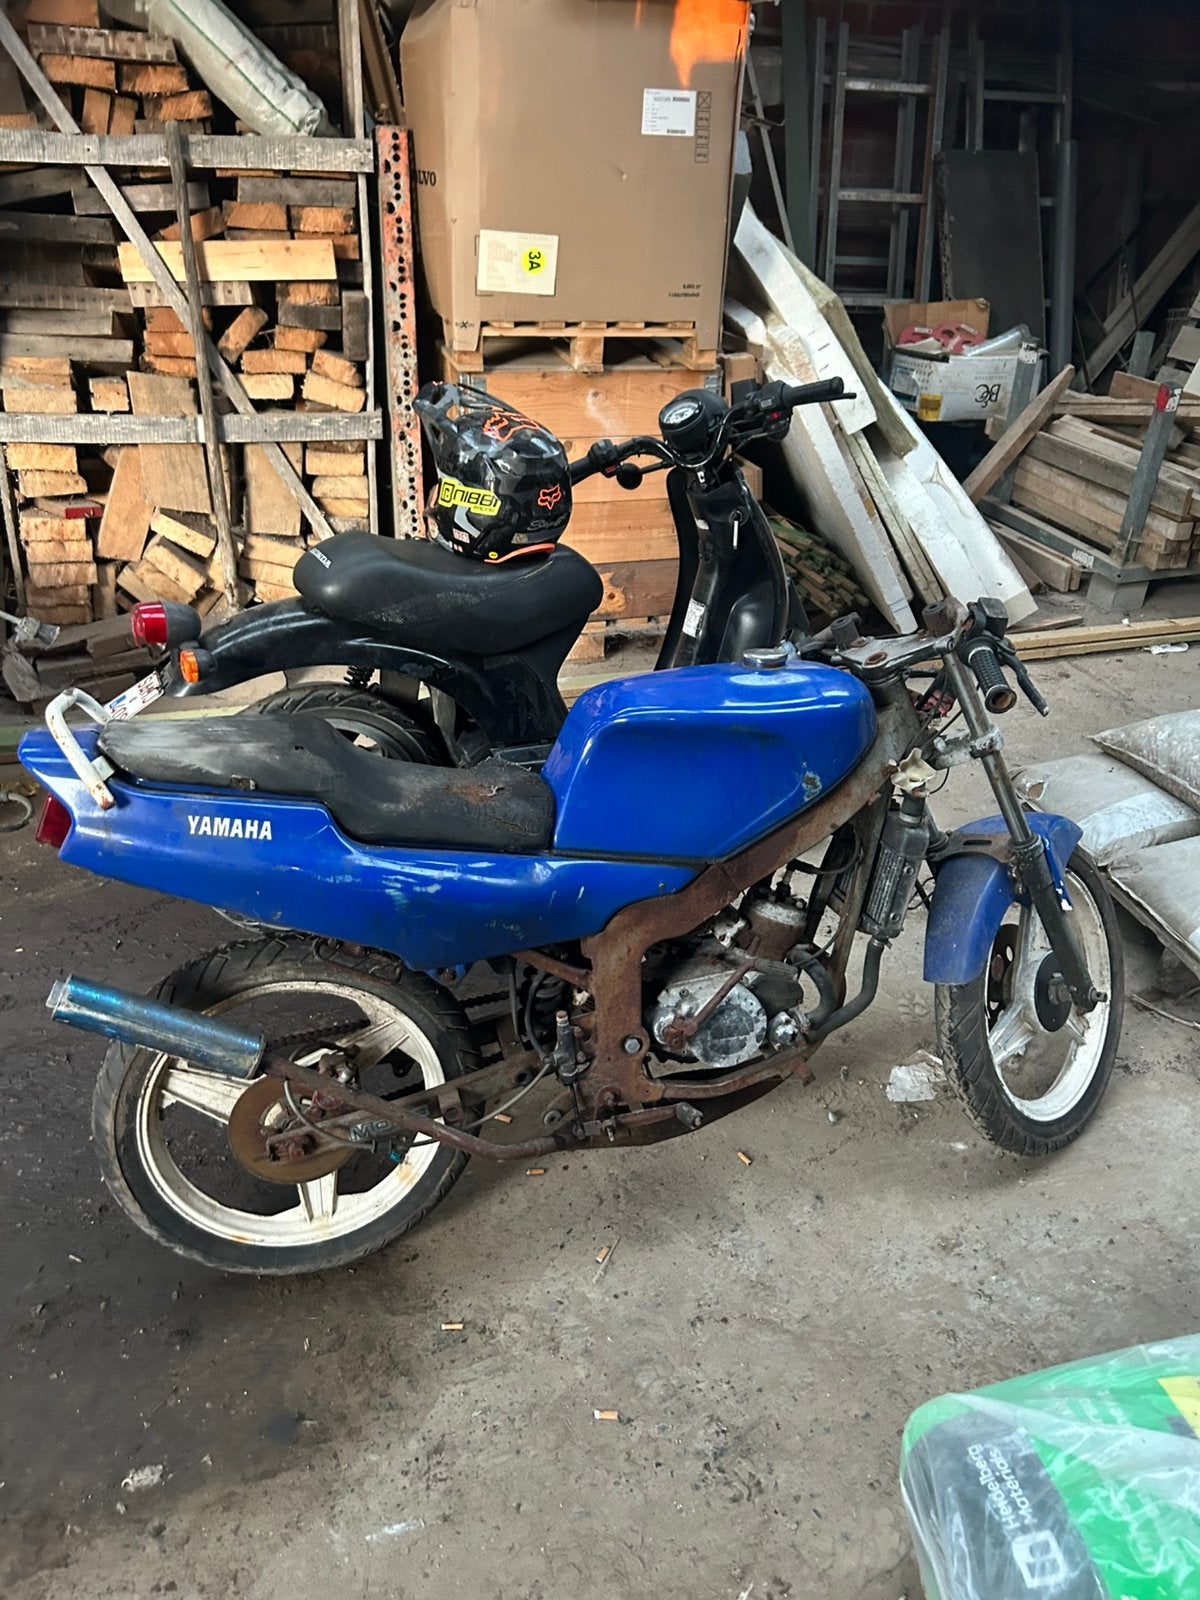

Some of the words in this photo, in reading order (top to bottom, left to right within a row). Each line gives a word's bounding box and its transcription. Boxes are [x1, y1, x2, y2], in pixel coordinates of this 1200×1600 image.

[417, 170, 437, 187] LVO
[528, 251, 542, 272] 3A
[310, 548, 332, 569] HONDA
[187, 815, 273, 841] YAMAHA
[967, 1443, 1021, 1530] Heidelberg
[989, 1447, 1039, 1525] Materials
